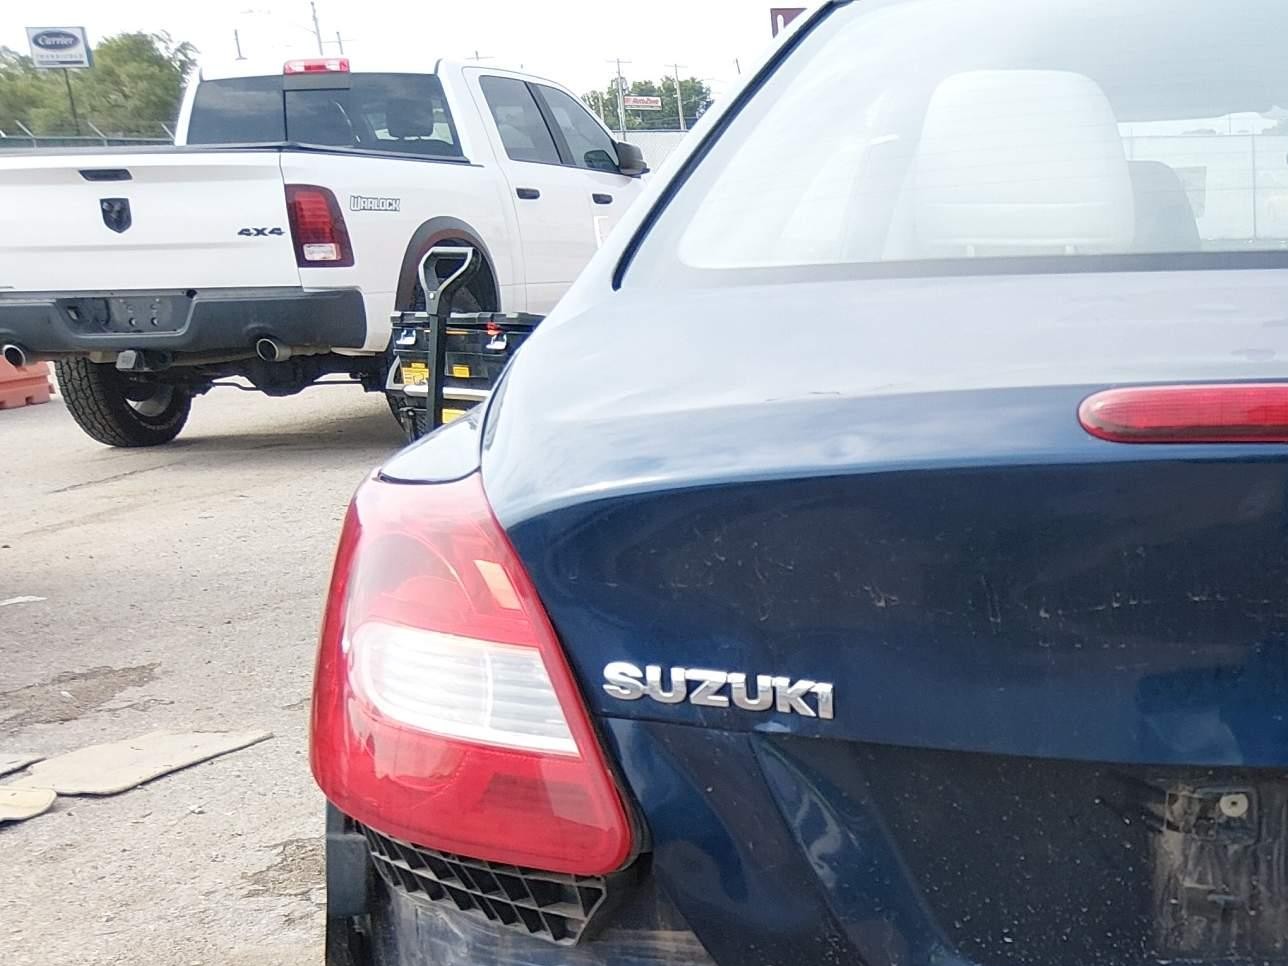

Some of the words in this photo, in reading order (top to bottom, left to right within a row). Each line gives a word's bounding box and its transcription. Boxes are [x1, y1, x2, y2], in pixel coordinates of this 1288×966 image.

[38, 35, 74, 46] Carrier
[350, 195, 400, 212] WARLOCK
[603, 661, 834, 719] SUZUKI
